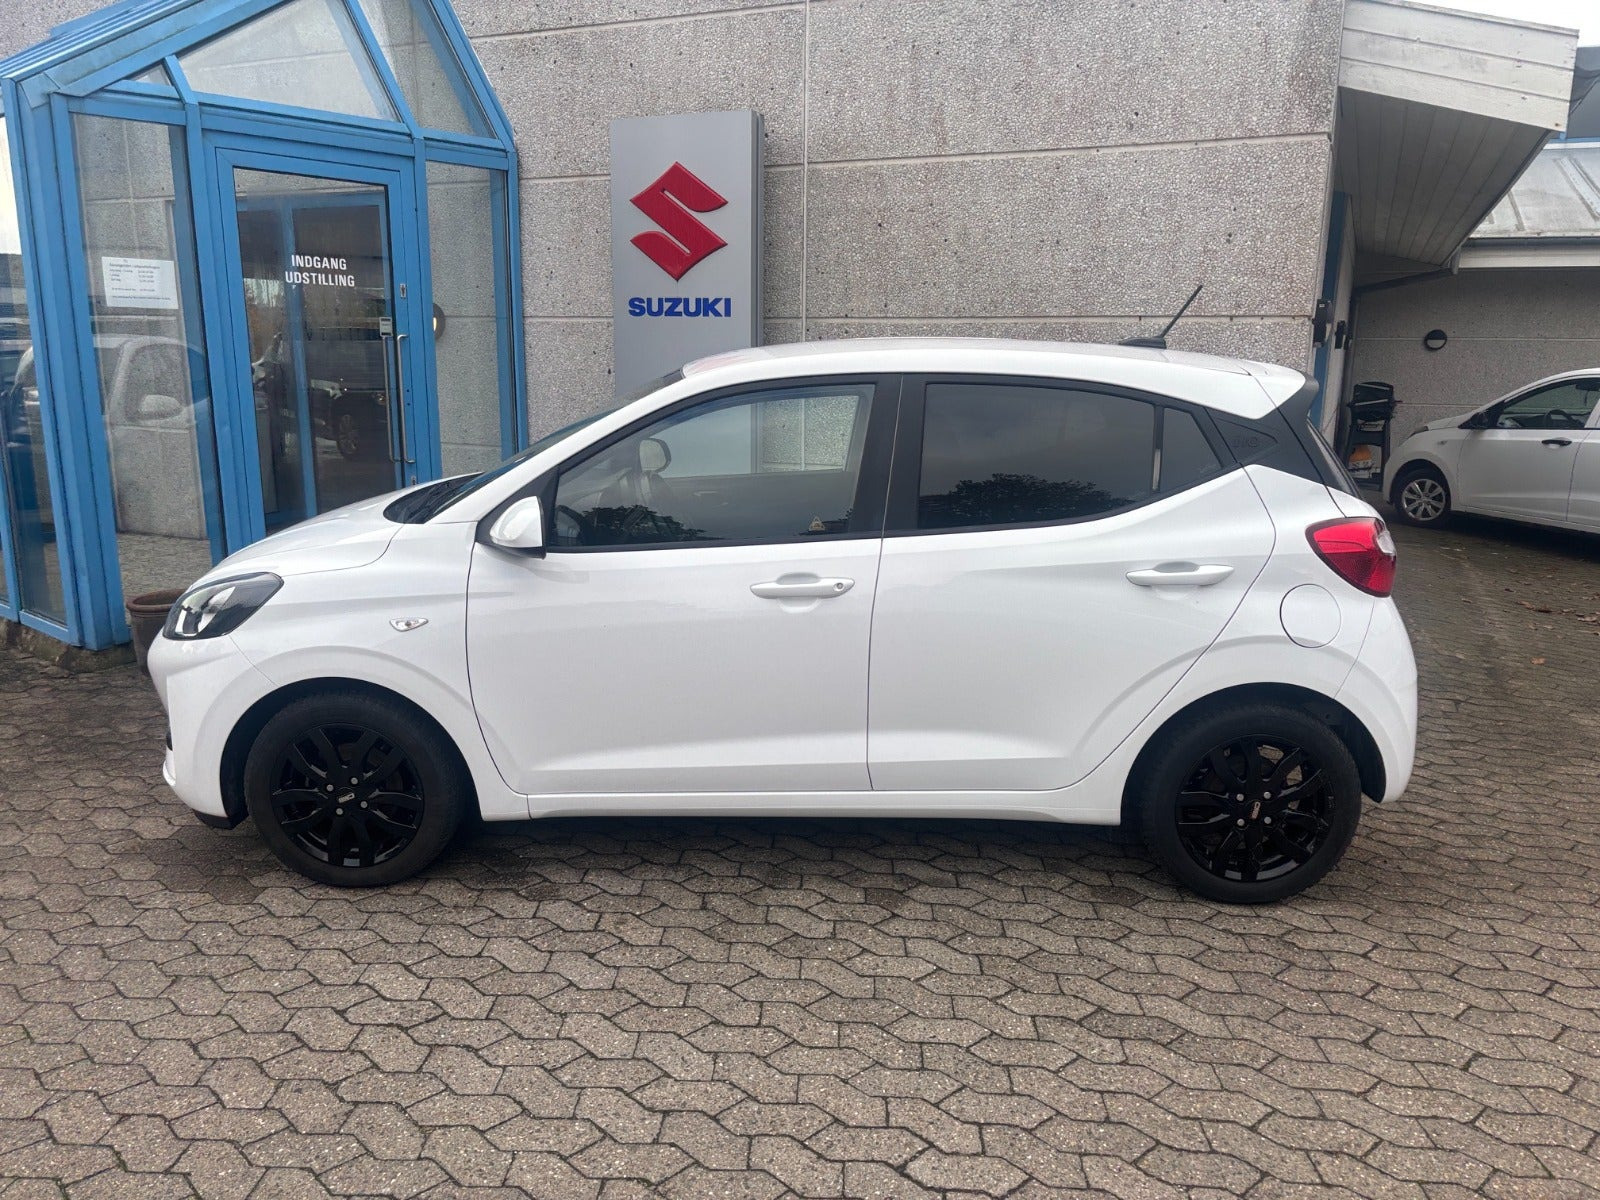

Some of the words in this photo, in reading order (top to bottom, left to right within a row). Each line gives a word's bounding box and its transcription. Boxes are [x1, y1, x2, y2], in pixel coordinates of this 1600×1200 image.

[291, 254, 347, 270] INDGANG
[285, 271, 355, 287] UDSTILLING
[628, 297, 731, 317] SUZUKI
